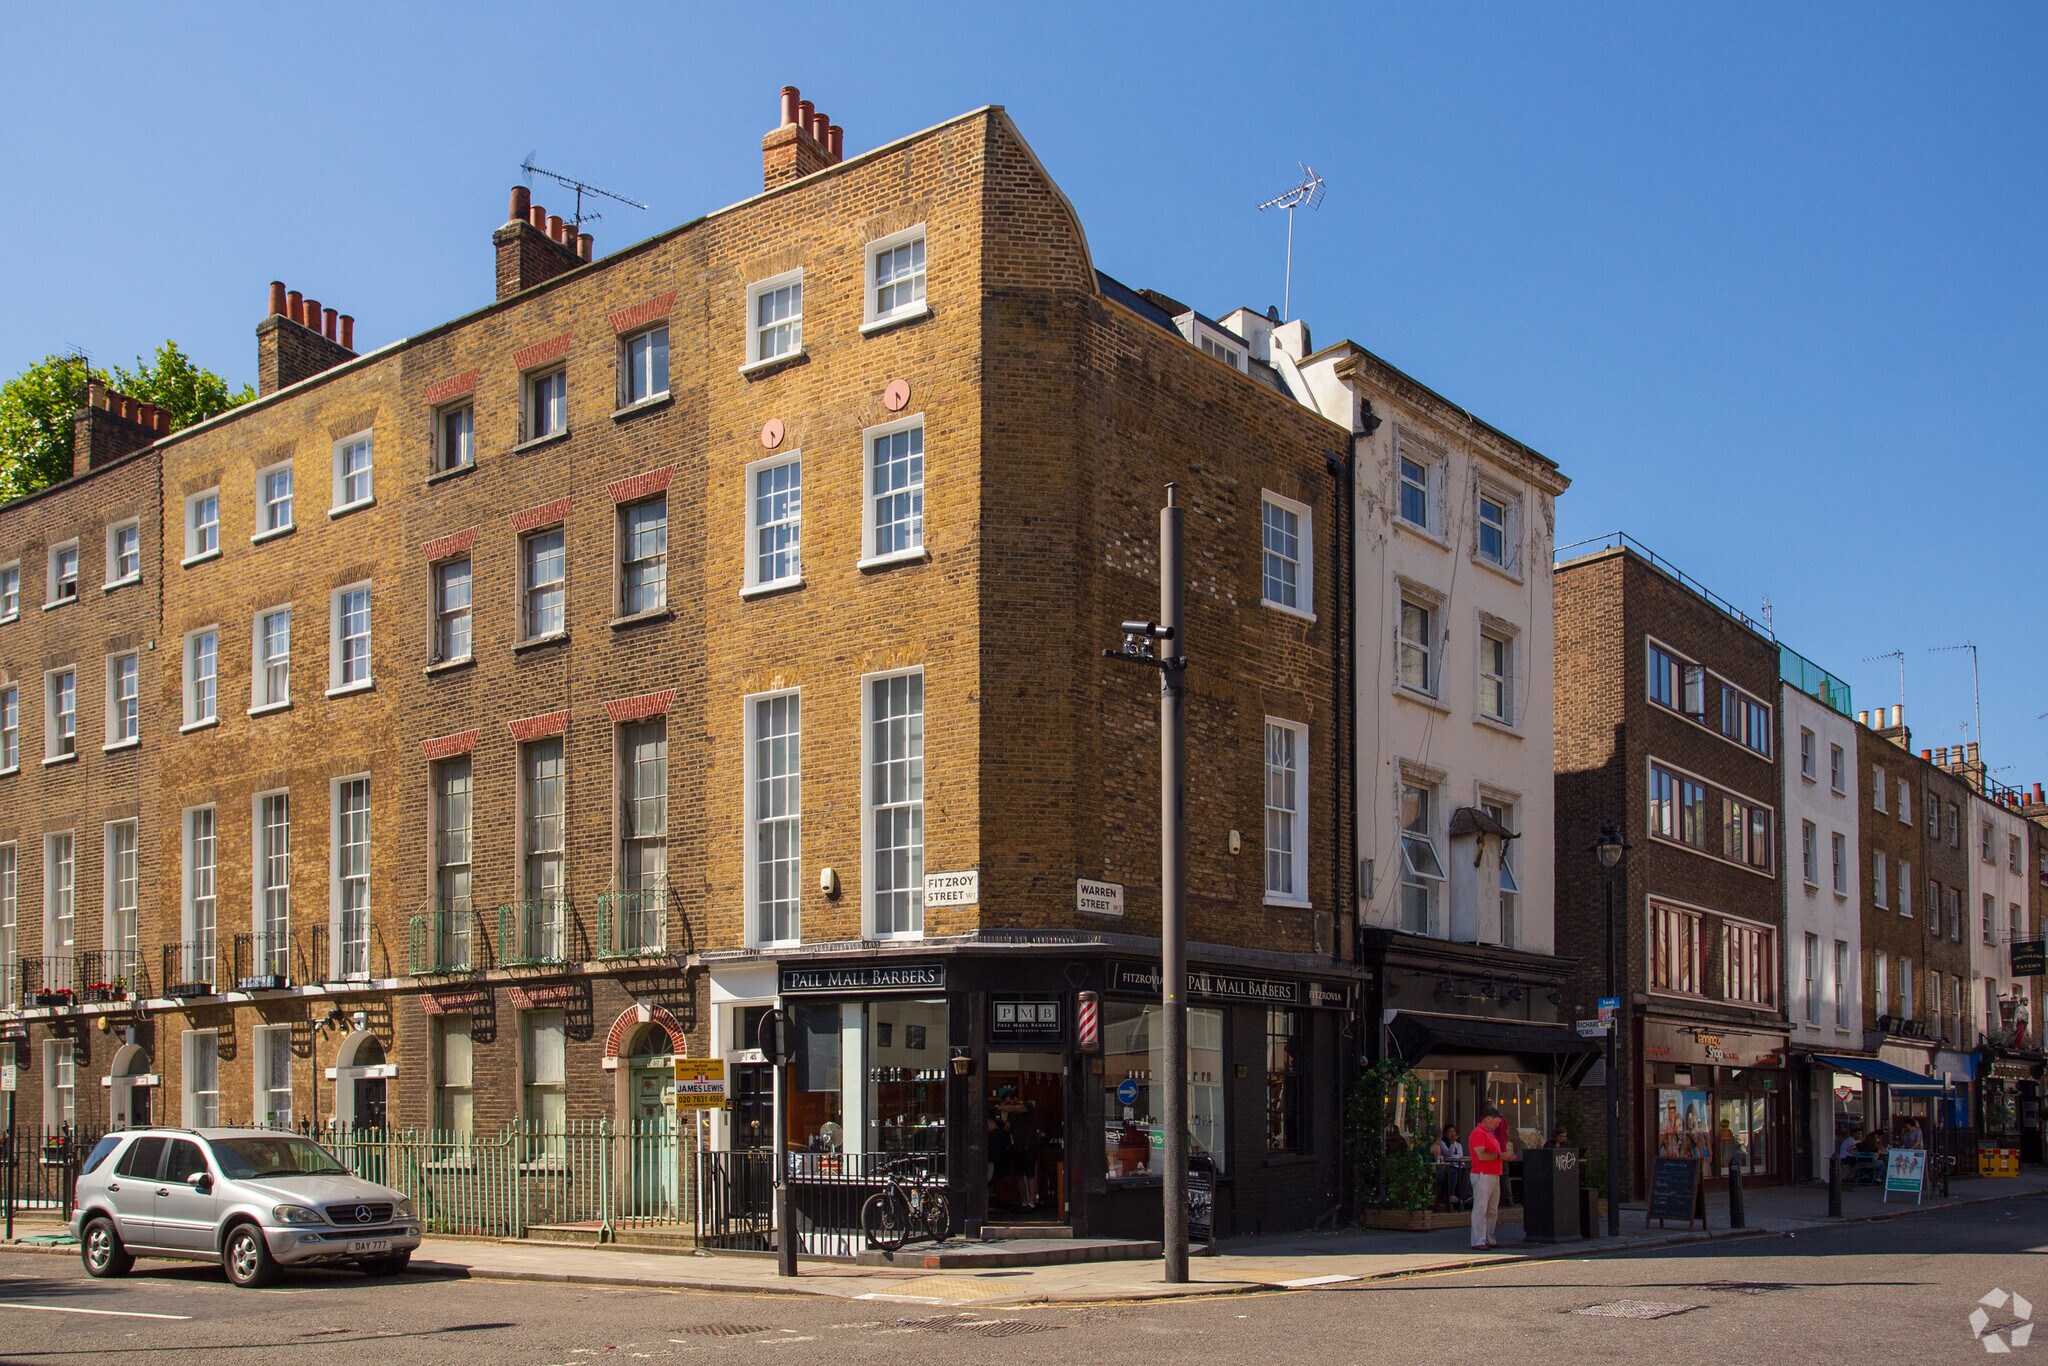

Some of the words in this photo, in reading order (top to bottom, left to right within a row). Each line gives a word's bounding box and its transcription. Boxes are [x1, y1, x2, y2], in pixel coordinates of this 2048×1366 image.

[928, 876, 974, 888] FITZROY
[928, 891, 964, 902] STREET
[1081, 884, 1116, 898] WARREN
[1081, 898, 1110, 910] STREET
[792, 973, 822, 988] PALL
[827, 971, 867, 987] MALL
[872, 969, 935, 985] BARBERS
[1188, 975, 1213, 992] PALL
[1216, 978, 1246, 994] MALL
[1248, 981, 1291, 998] BARBERS
[1309, 990, 1342, 1001] FITZROVIA
[677, 1085, 703, 1093] JAMES
[703, 1084, 723, 1092] LEWIS
[355, 1242, 370, 1251] DAY
[372, 1240, 387, 1250] 777
